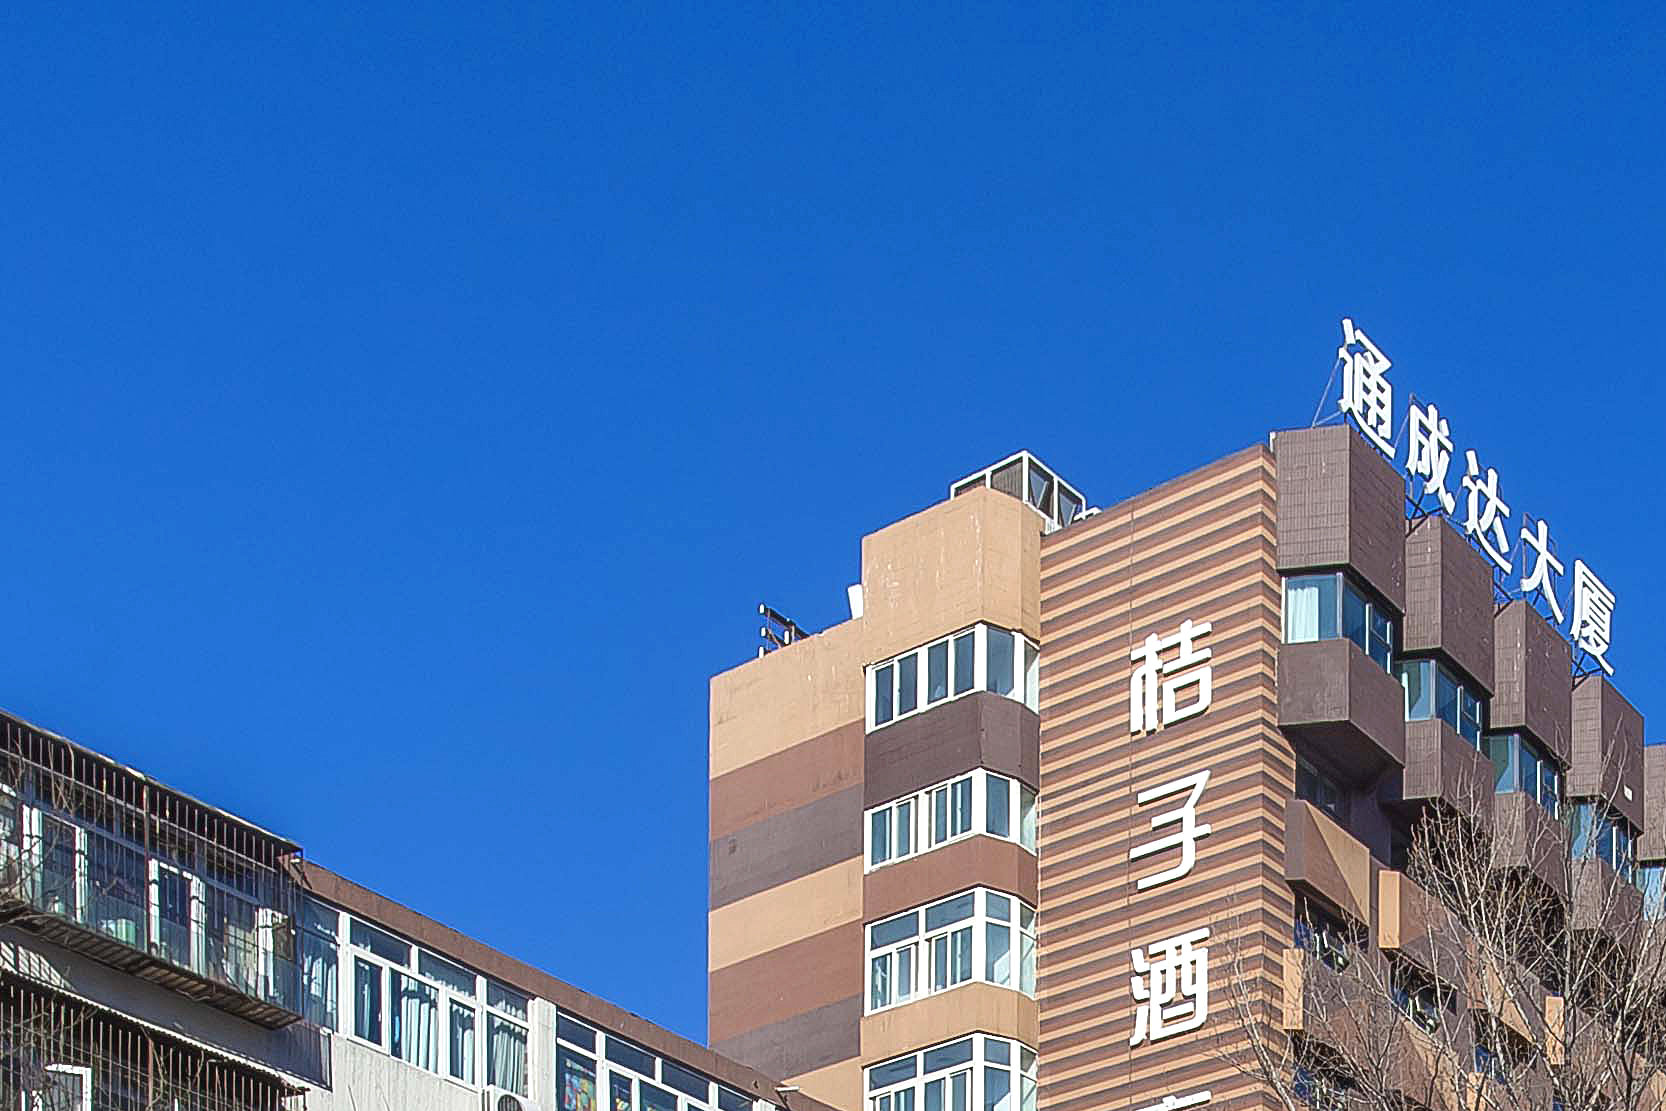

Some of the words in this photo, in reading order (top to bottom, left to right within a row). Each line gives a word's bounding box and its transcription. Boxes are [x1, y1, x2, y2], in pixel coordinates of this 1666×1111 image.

[1338, 318, 1616, 676] 通成达大厦
